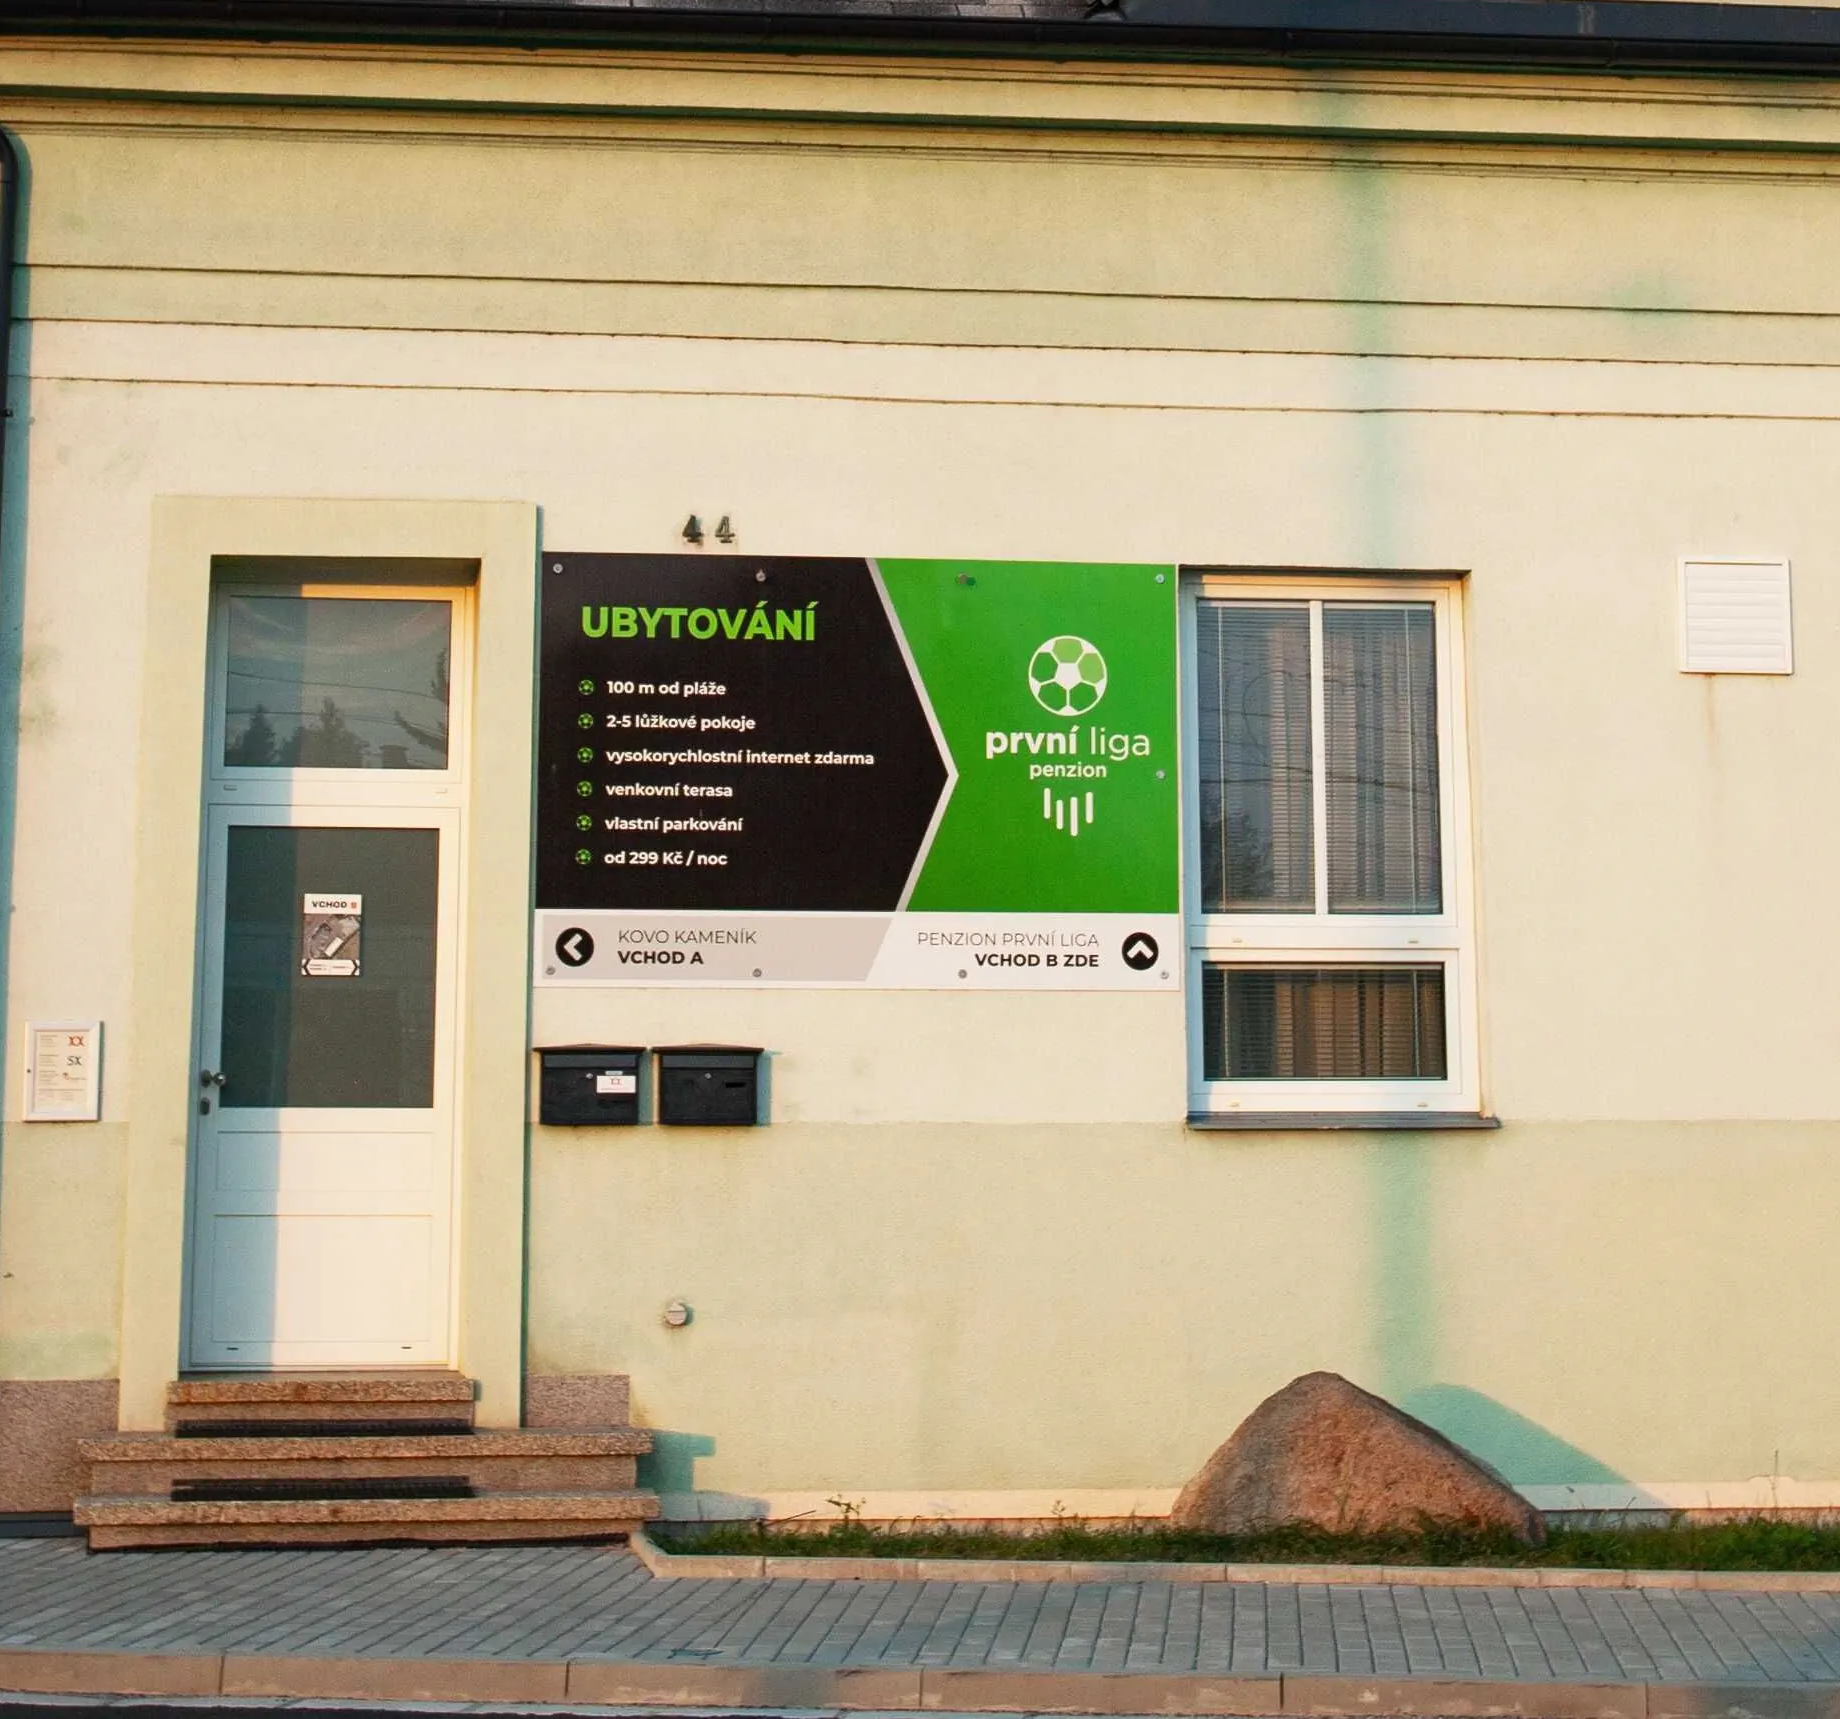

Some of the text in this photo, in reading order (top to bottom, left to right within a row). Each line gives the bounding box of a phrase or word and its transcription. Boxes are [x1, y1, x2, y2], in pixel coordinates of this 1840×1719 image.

[581, 600, 820, 641] UBYTOVÁNÍ
[607, 680, 726, 697] 100 m od pláže
[606, 714, 756, 732] 2-5 lůžkové pokoje
[985, 725, 1150, 761] první liga
[606, 748, 874, 766] vysokorychlostní internet zdarma
[1029, 761, 1107, 780] penzion
[605, 782, 733, 797] venkovní terasa
[605, 816, 743, 833] vlastní parkování
[604, 851, 625, 865] od
[628, 851, 658, 865] 299
[663, 851, 683, 865] Kč
[697, 854, 728, 866] noc
[312, 900, 348, 909] VCHOD
[618, 927, 757, 944] KOVO KAMENÍK
[917, 930, 1100, 948] PENZION PRVNÍ LIGA
[618, 950, 704, 965] VCHOD A
[975, 953, 1099, 968] VCHOD B ZDE
